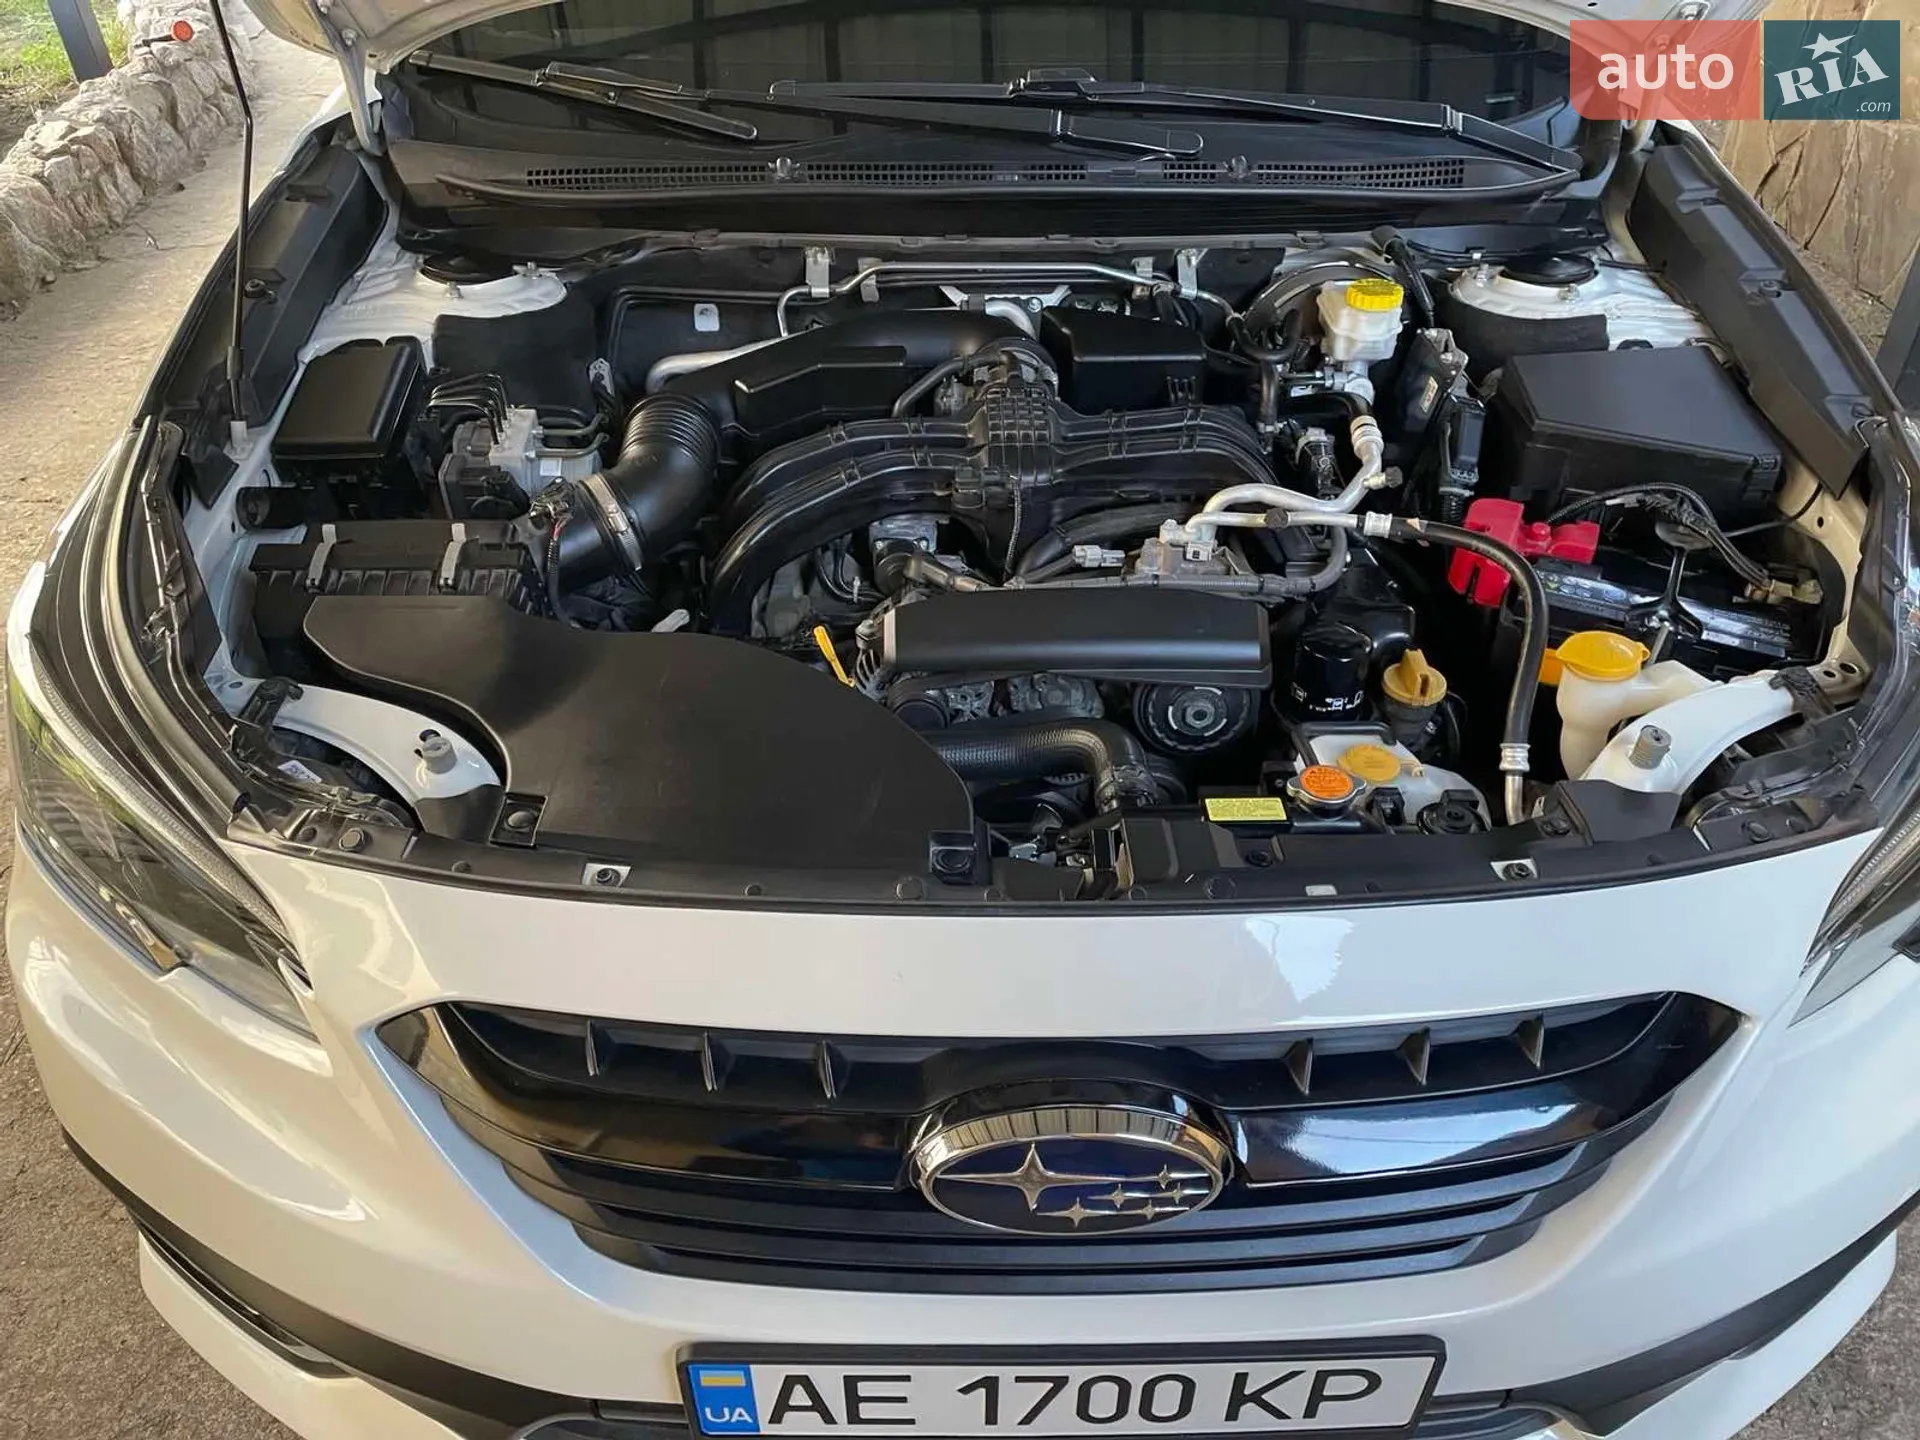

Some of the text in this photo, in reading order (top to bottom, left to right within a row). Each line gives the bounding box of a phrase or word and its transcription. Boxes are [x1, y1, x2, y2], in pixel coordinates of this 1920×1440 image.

[704, 1407, 753, 1424] UA
[768, 1368, 1382, 1426] AE 1700 KP
